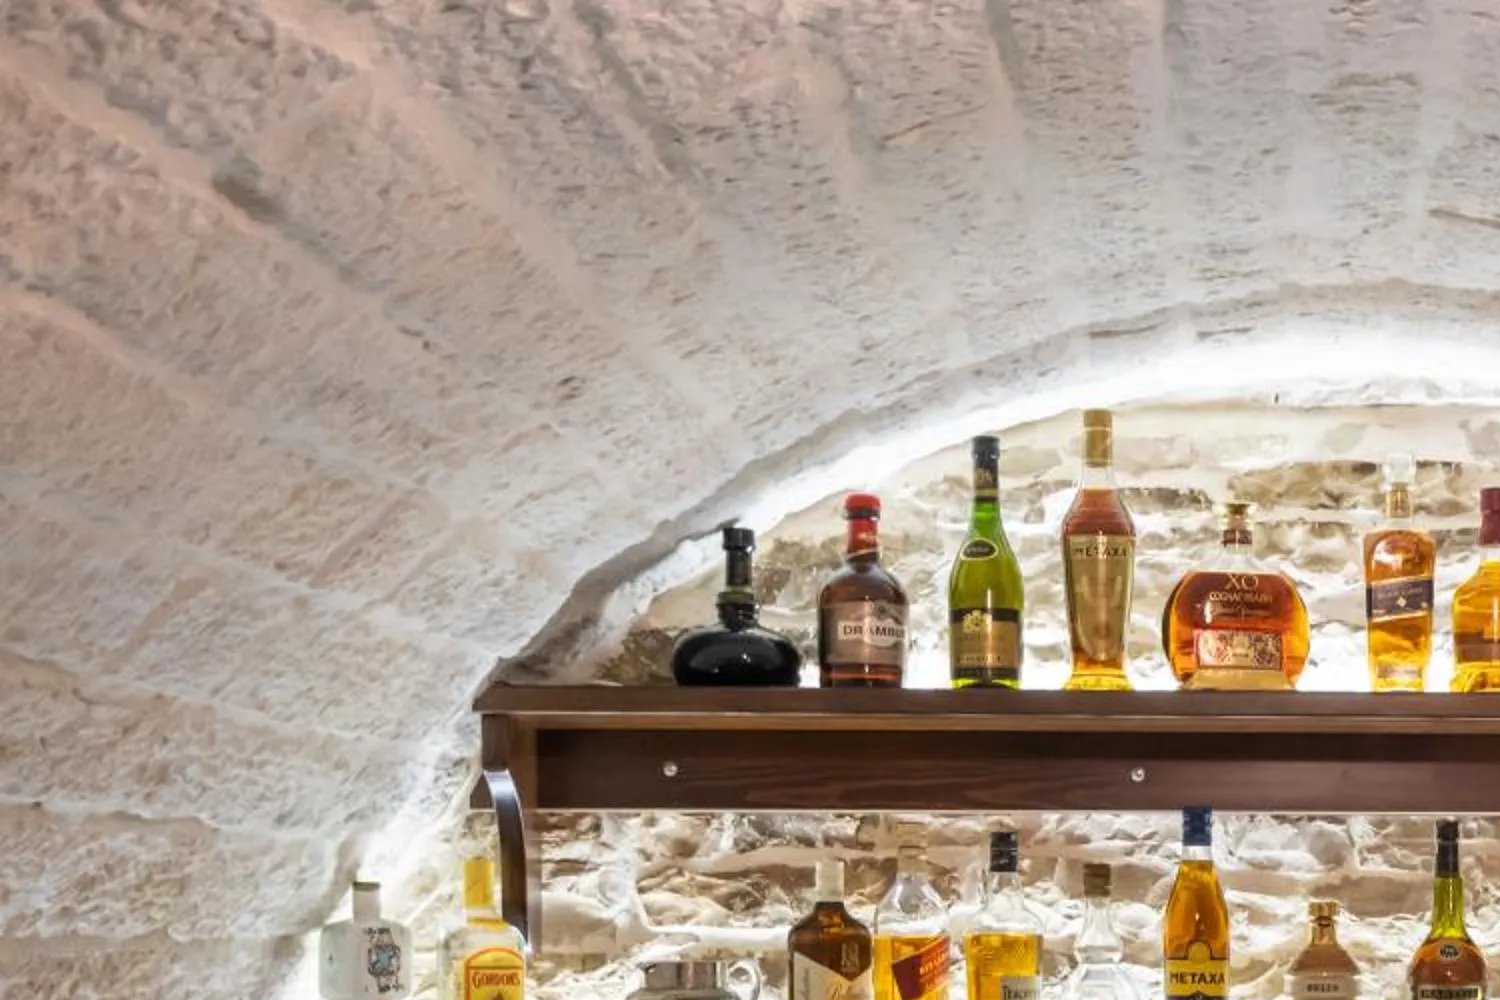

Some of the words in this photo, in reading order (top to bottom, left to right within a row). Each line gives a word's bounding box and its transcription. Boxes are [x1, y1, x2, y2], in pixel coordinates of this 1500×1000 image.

[1073, 546, 1128, 558] METAXA
[1224, 572, 1259, 589] XO
[1170, 971, 1226, 985] METAXA
